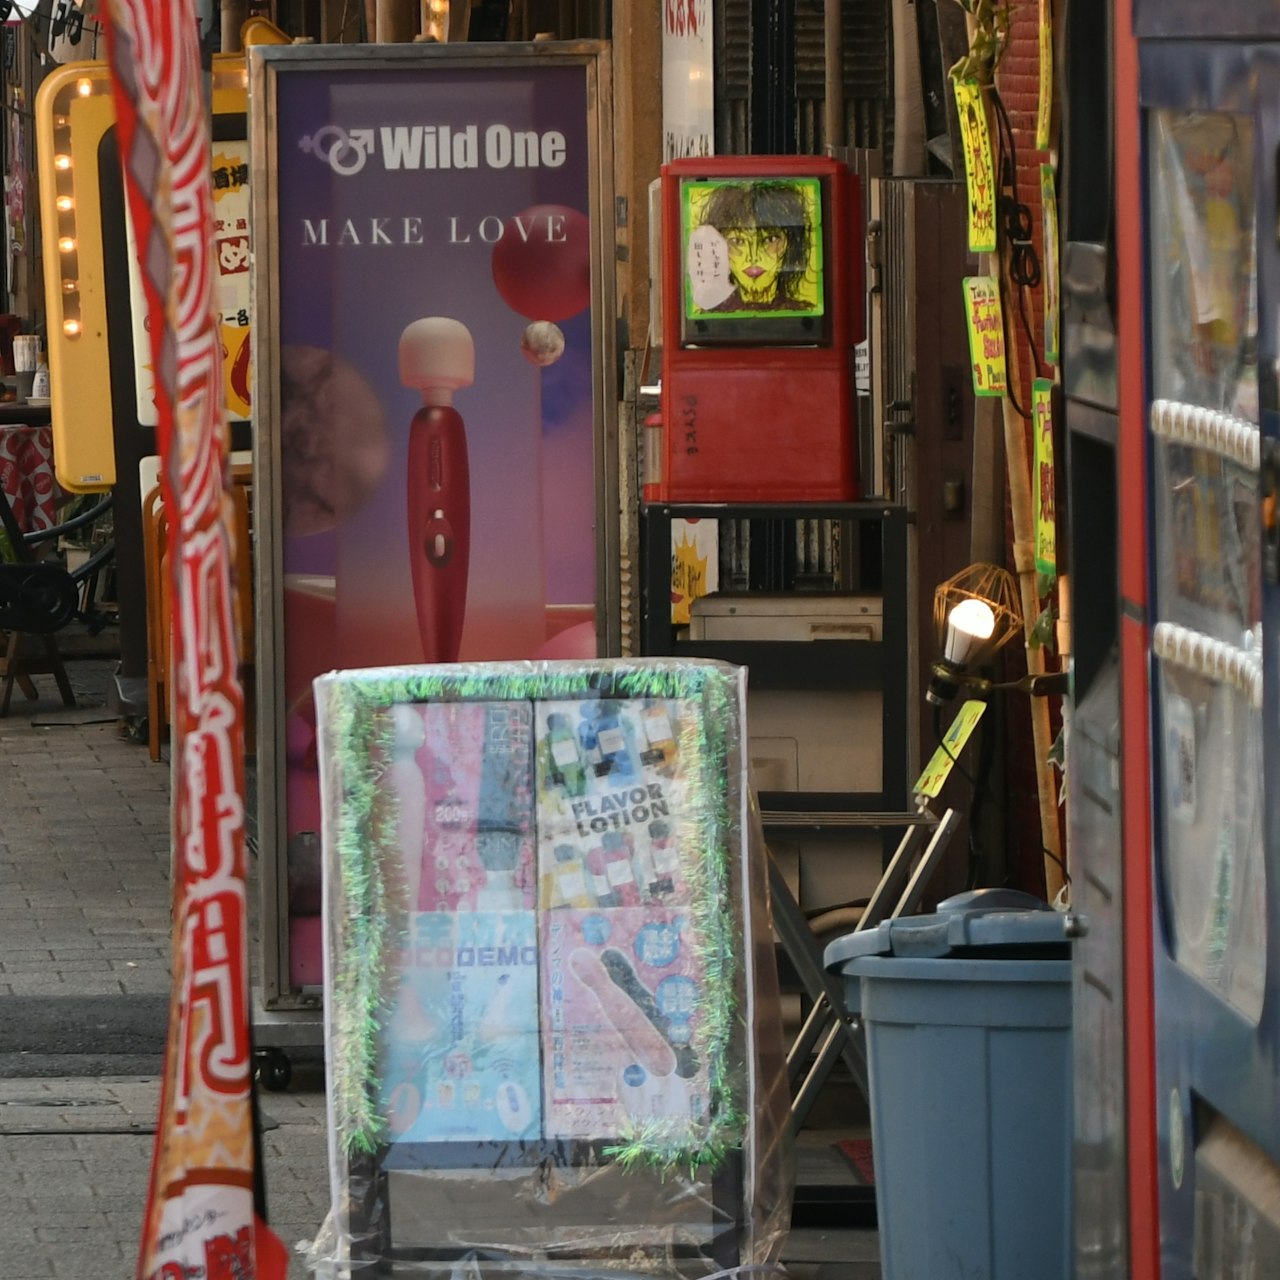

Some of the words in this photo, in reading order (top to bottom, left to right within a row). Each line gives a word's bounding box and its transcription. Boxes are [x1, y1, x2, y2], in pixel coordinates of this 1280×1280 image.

[380, 124, 479, 170] Wild
[485, 123, 567, 169] One
[302, 217, 424, 245] MAKE
[448, 215, 568, 243] LOVE
[571, 783, 665, 820] FLAVOR
[575, 800, 670, 839] LOTION
